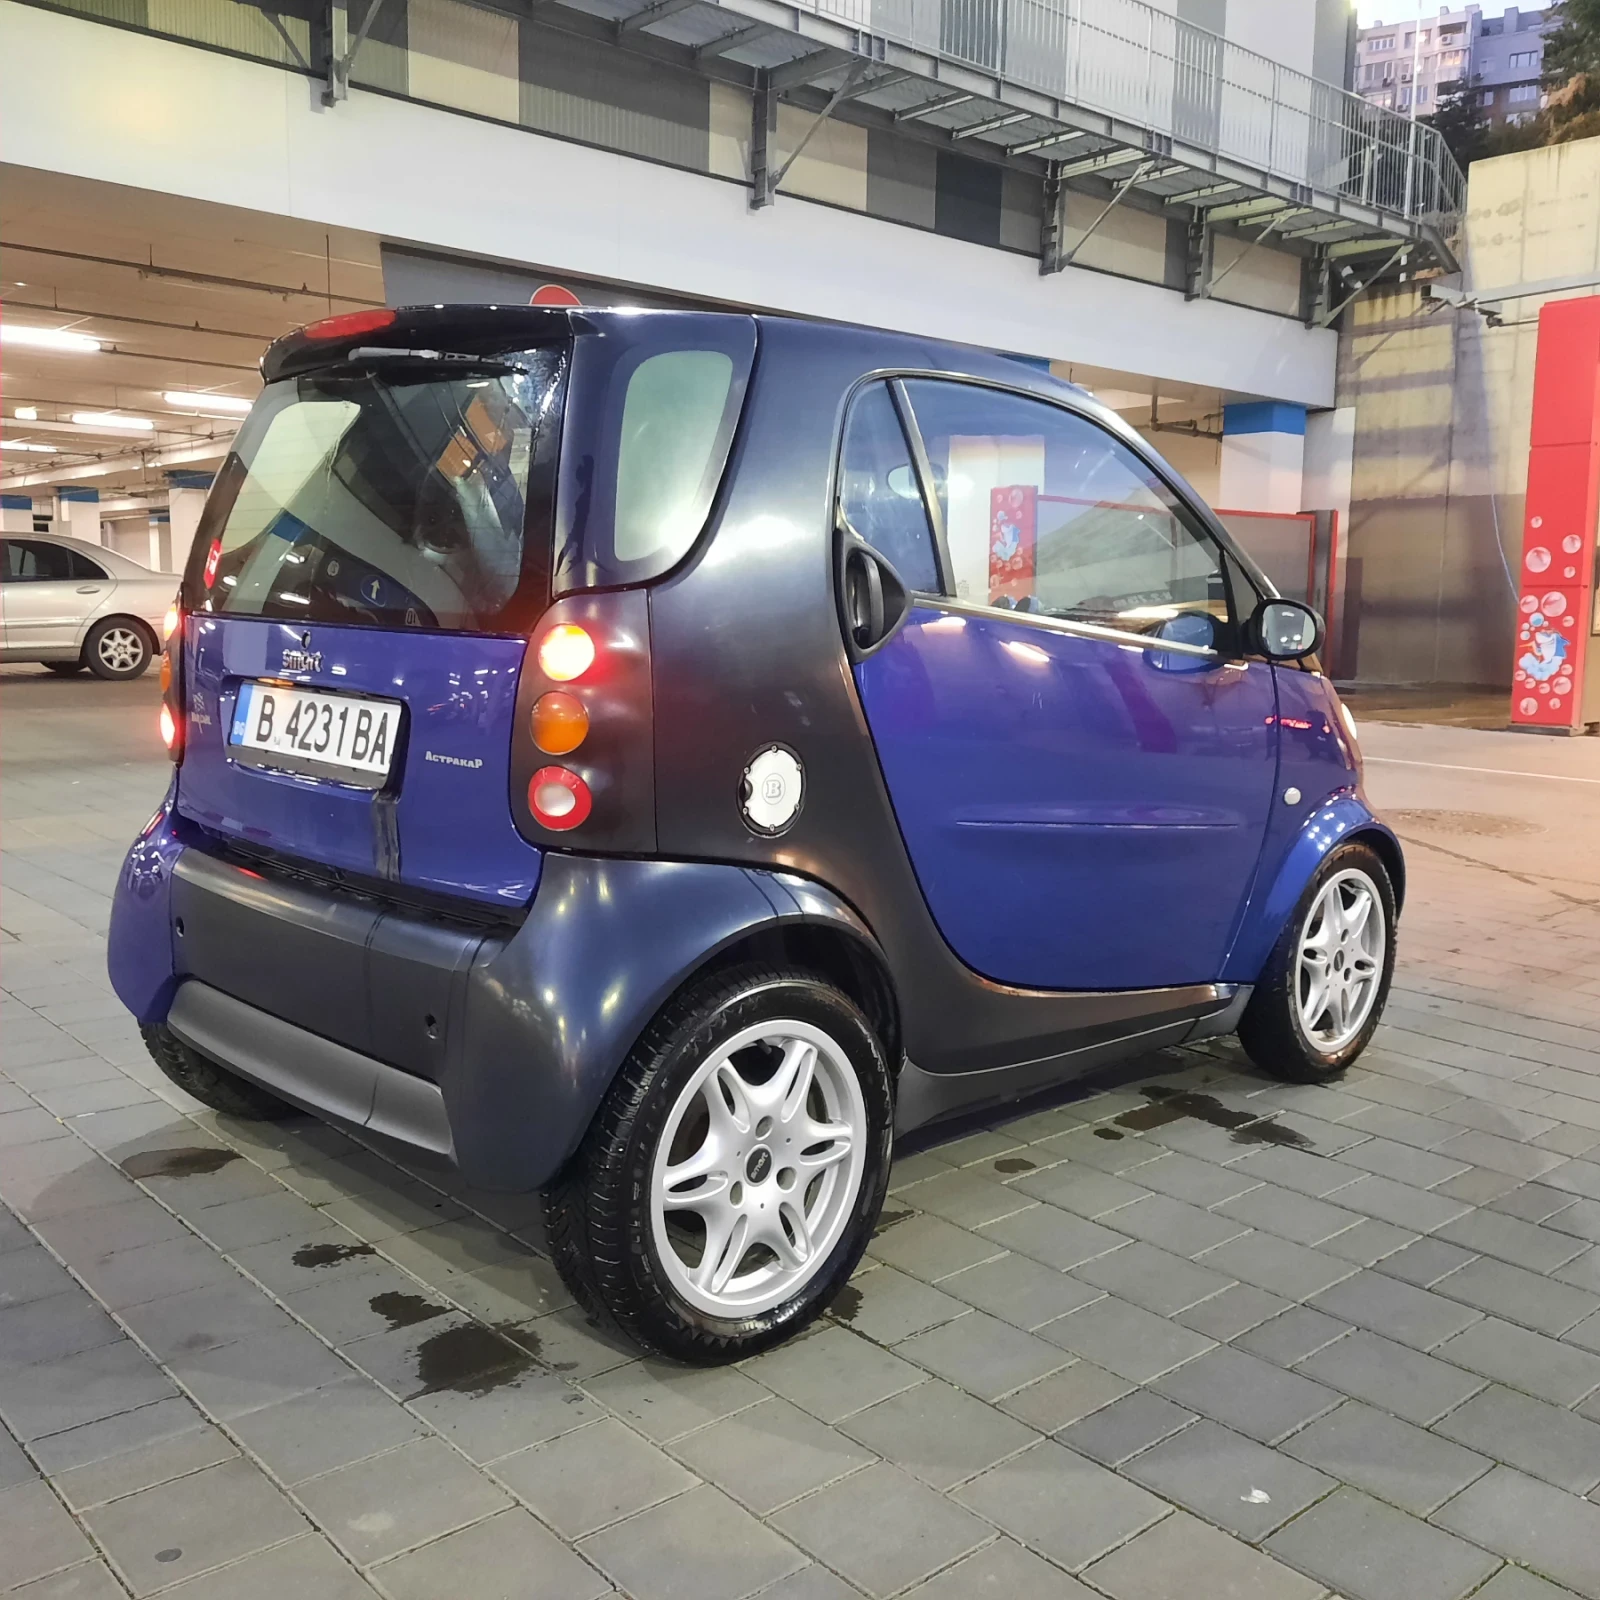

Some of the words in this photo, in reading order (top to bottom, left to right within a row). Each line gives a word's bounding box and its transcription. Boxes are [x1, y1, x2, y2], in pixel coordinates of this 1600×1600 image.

[256, 694, 275, 743] B
[285, 699, 349, 757] 4231
[350, 708, 389, 766] BA
[766, 780, 781, 798] B
[750, 1152, 769, 1180] smart
